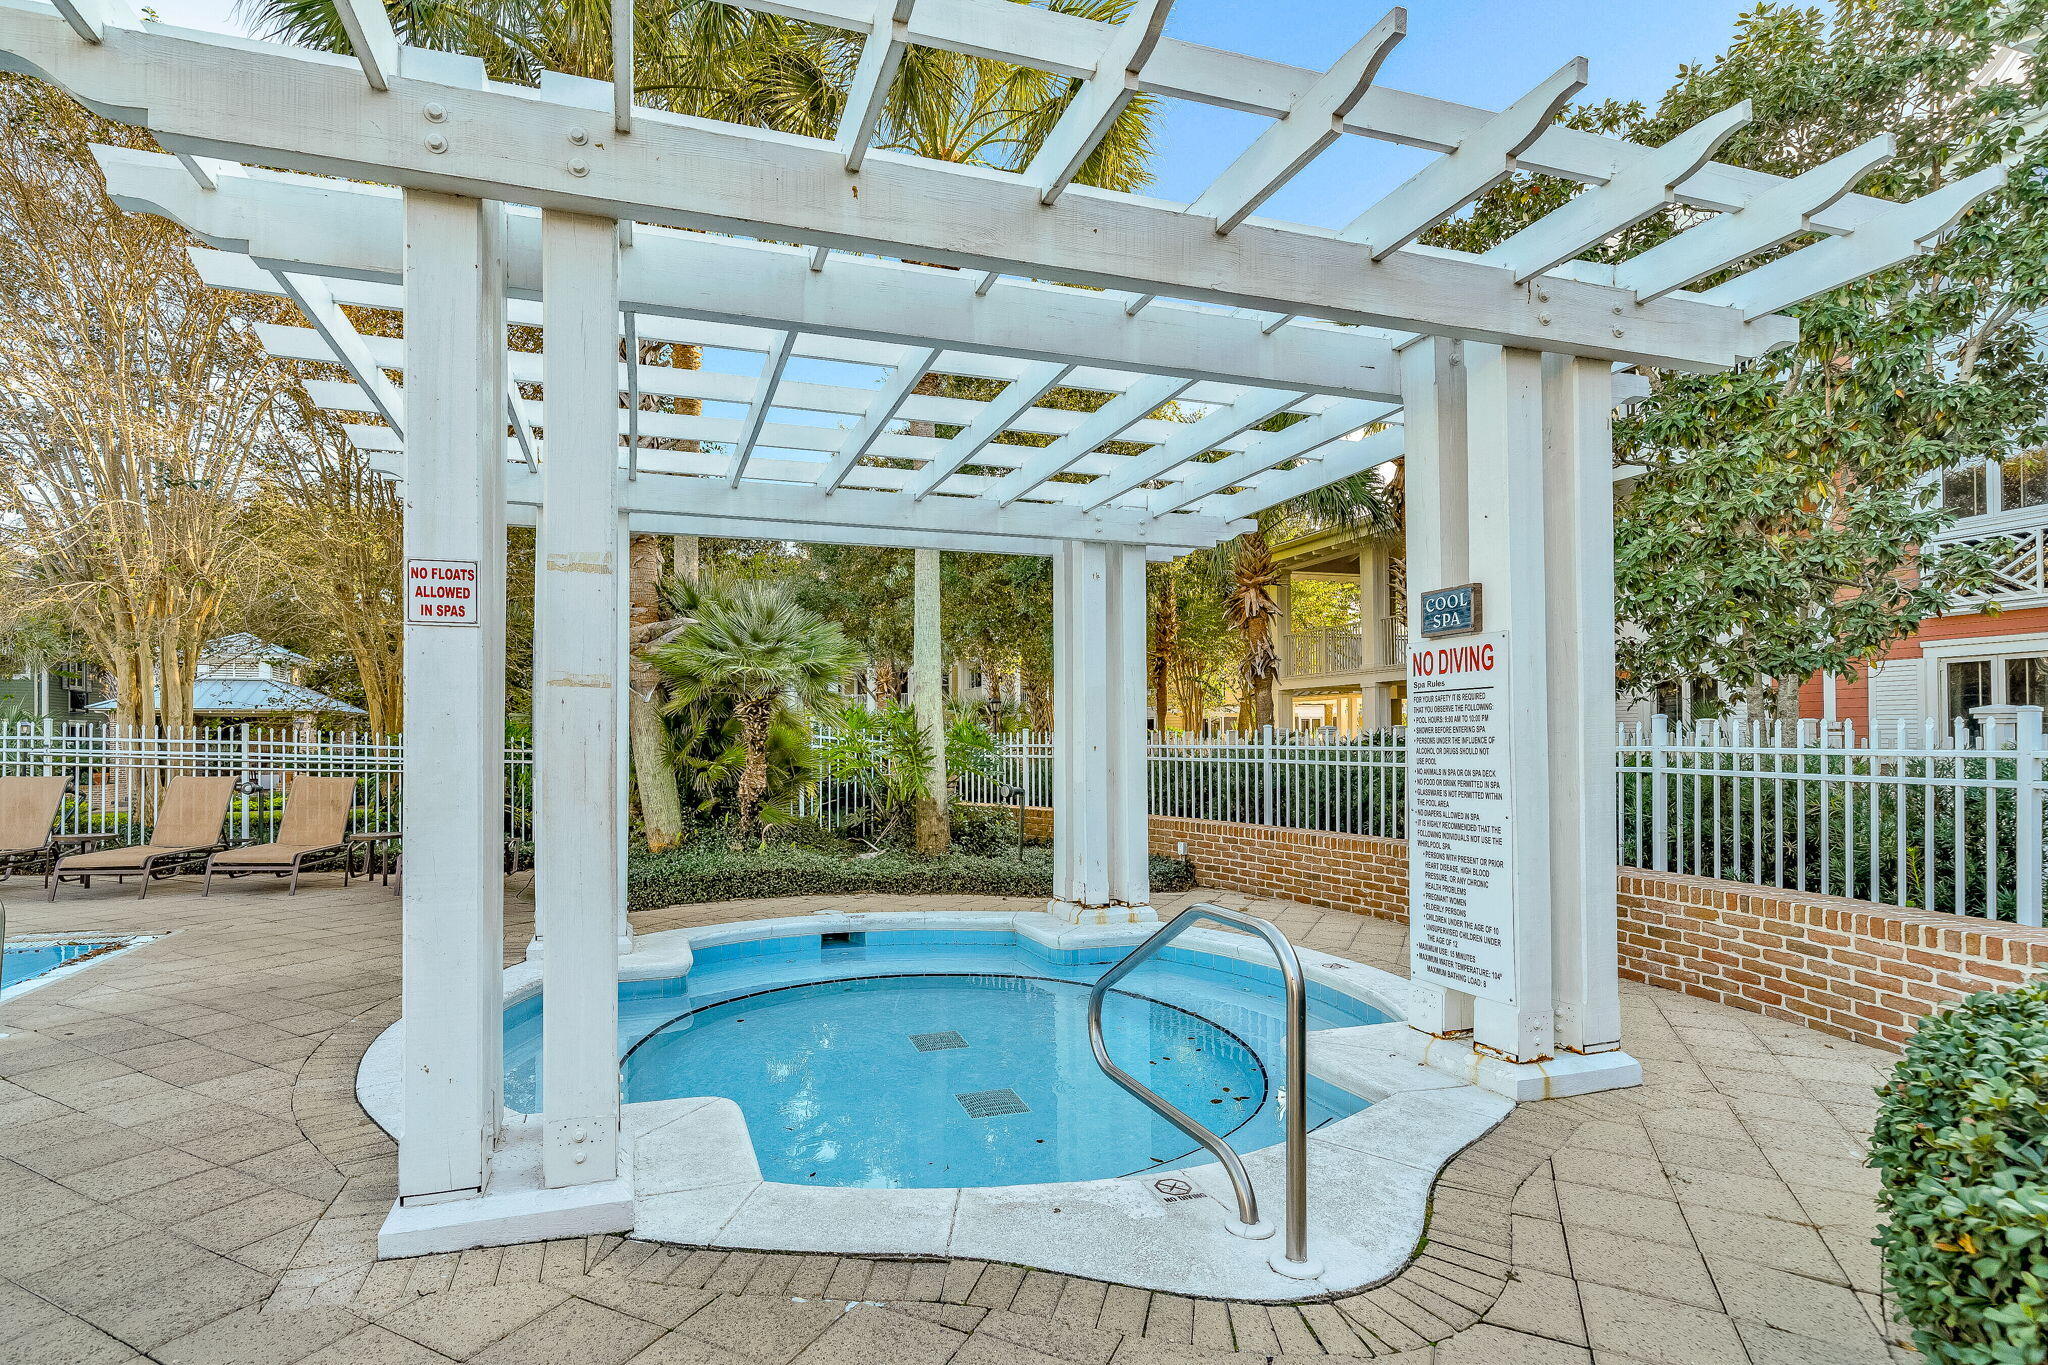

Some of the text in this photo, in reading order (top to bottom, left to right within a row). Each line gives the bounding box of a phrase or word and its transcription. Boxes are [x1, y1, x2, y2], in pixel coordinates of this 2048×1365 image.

[411, 567, 475, 581] NO FLOATS
[415, 586, 471, 599] ALLOWED
[1426, 593, 1468, 612] COOL
[420, 604, 465, 617] IN SPAS
[1433, 612, 1460, 628] SPA
[1413, 644, 1494, 677] NO DIVING
[1413, 680, 1445, 690] Spa Rules
[1435, 694, 1451, 702] SAFETY
[1434, 705, 1454, 713] OBSERVE
[1455, 704, 1464, 712] THE
[1461, 736, 1488, 744] INFLUENCE
[1488, 736, 1495, 744] OF
[1424, 768, 1442, 776] ANIMALS
[1457, 769, 1464, 777] OR
[1464, 769, 1472, 777] ON
[1443, 779, 1456, 787] DRINK
[1457, 780, 1484, 788] PERMITTED
[1490, 781, 1500, 789] SPA
[1417, 789, 1442, 797] GLASSWARE
[1458, 791, 1484, 800] PERMITTED
[1485, 792, 1503, 800] WITHIN
[1426, 799, 1437, 807] POOL
[1443, 811, 1464, 819] ALLOWED
[1427, 820, 1441, 828] HIGHLY
[1442, 821, 1477, 831] RECOMMENDED
[1478, 824, 1490, 832] THAT
[1491, 826, 1501, 834] THE
[1417, 830, 1441, 839] FOLLOWING
[1442, 832, 1469, 842] INDIVIDUALS
[1470, 835, 1481, 843] NOT
[1481, 836, 1491, 844] USE
[1417, 840, 1441, 849] WHIRLPOOL
[1425, 851, 1504, 868] PERSONS WITH PRESENT OR PRIOR
[1425, 862, 1439, 870] HEART
[1460, 867, 1472, 875] HIGH
[1472, 868, 1489, 878] BLOOD
[1425, 882, 1467, 896] HEALTH PROBLEMS
[1457, 877, 1467, 885] ANY
[1467, 879, 1489, 888] CHRONIC
[1426, 893, 1467, 906] PREGNANT WOMEN
[1426, 903, 1467, 917] ELDERLY PERSONS
[1426, 913, 1447, 924] CHILDREN
[1448, 917, 1463, 928] UNDER
[1464, 920, 1473, 929] THE
[1474, 923, 1484, 933] AGE
[1485, 925, 1492, 933] OF
[1426, 924, 1458, 937] UNSUPERVISED
[1459, 931, 1483, 942] CHILDREN
[1427, 934, 1435, 942] THE
[1436, 936, 1445, 944] AGE
[1418, 942, 1439, 953] MAXIMUM
[1450, 950, 1455, 958] 15
[1455, 952, 1476, 963] MINUTES
[1419, 952, 1439, 964] MAXIMUM
[1439, 958, 1454, 968] WATER
[1427, 965, 1447, 976] MAXIMUM
[1447, 971, 1467, 982] BATHING
[1483, 980, 1487, 988] 8
[1178, 1193, 1208, 1201] DIVING
